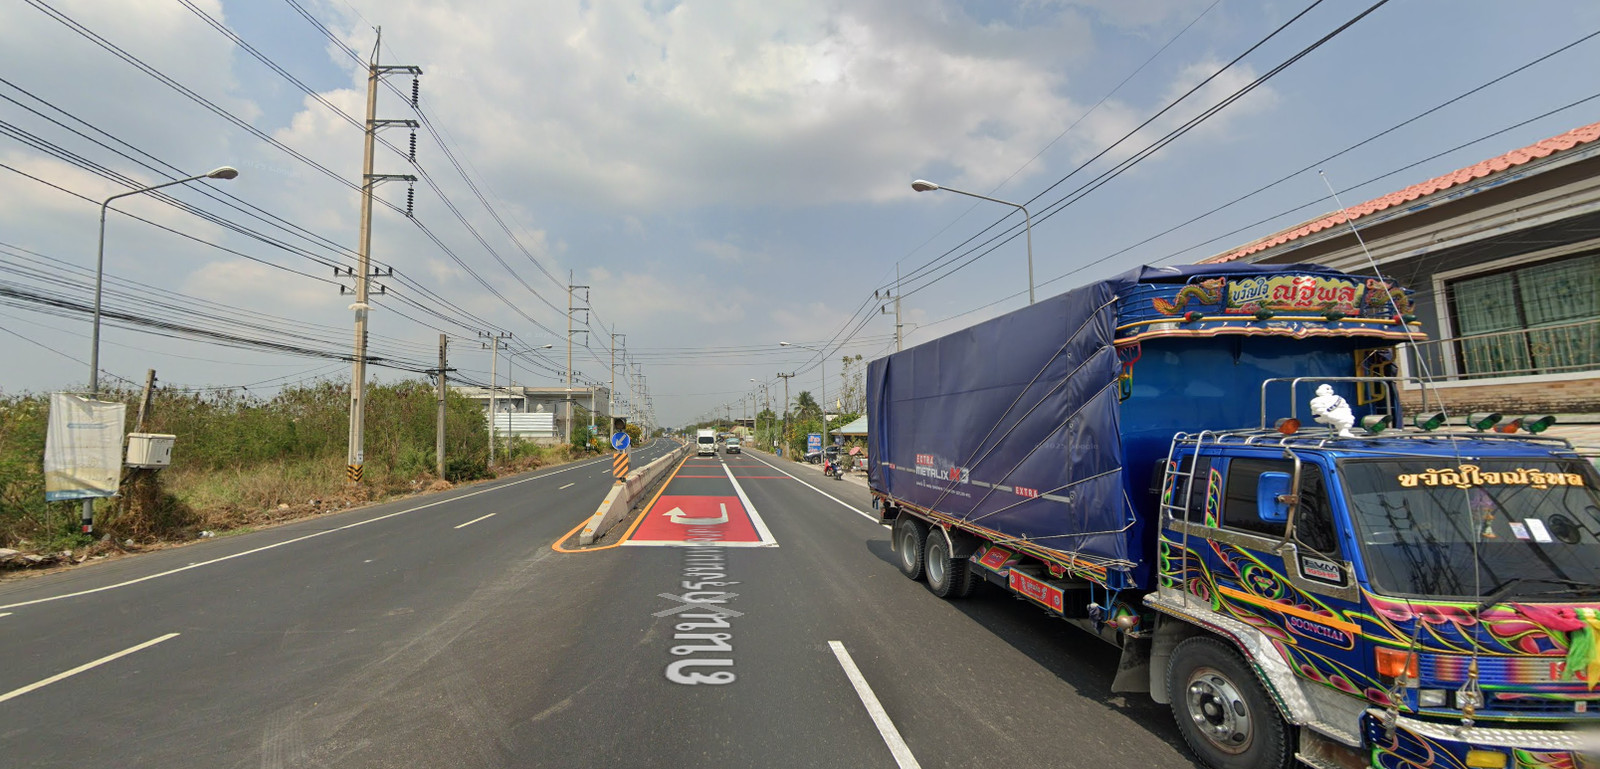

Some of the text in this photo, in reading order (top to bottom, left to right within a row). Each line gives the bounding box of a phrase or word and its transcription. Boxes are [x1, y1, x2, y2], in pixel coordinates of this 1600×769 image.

[1232, 276, 1357, 307] ขวัญใจ ณัฐพล
[1398, 464, 1585, 489] ขวัญใจณัฐพล
[1015, 486, 1038, 498] EXTRA
[1290, 616, 1344, 642] SOONCHAI
